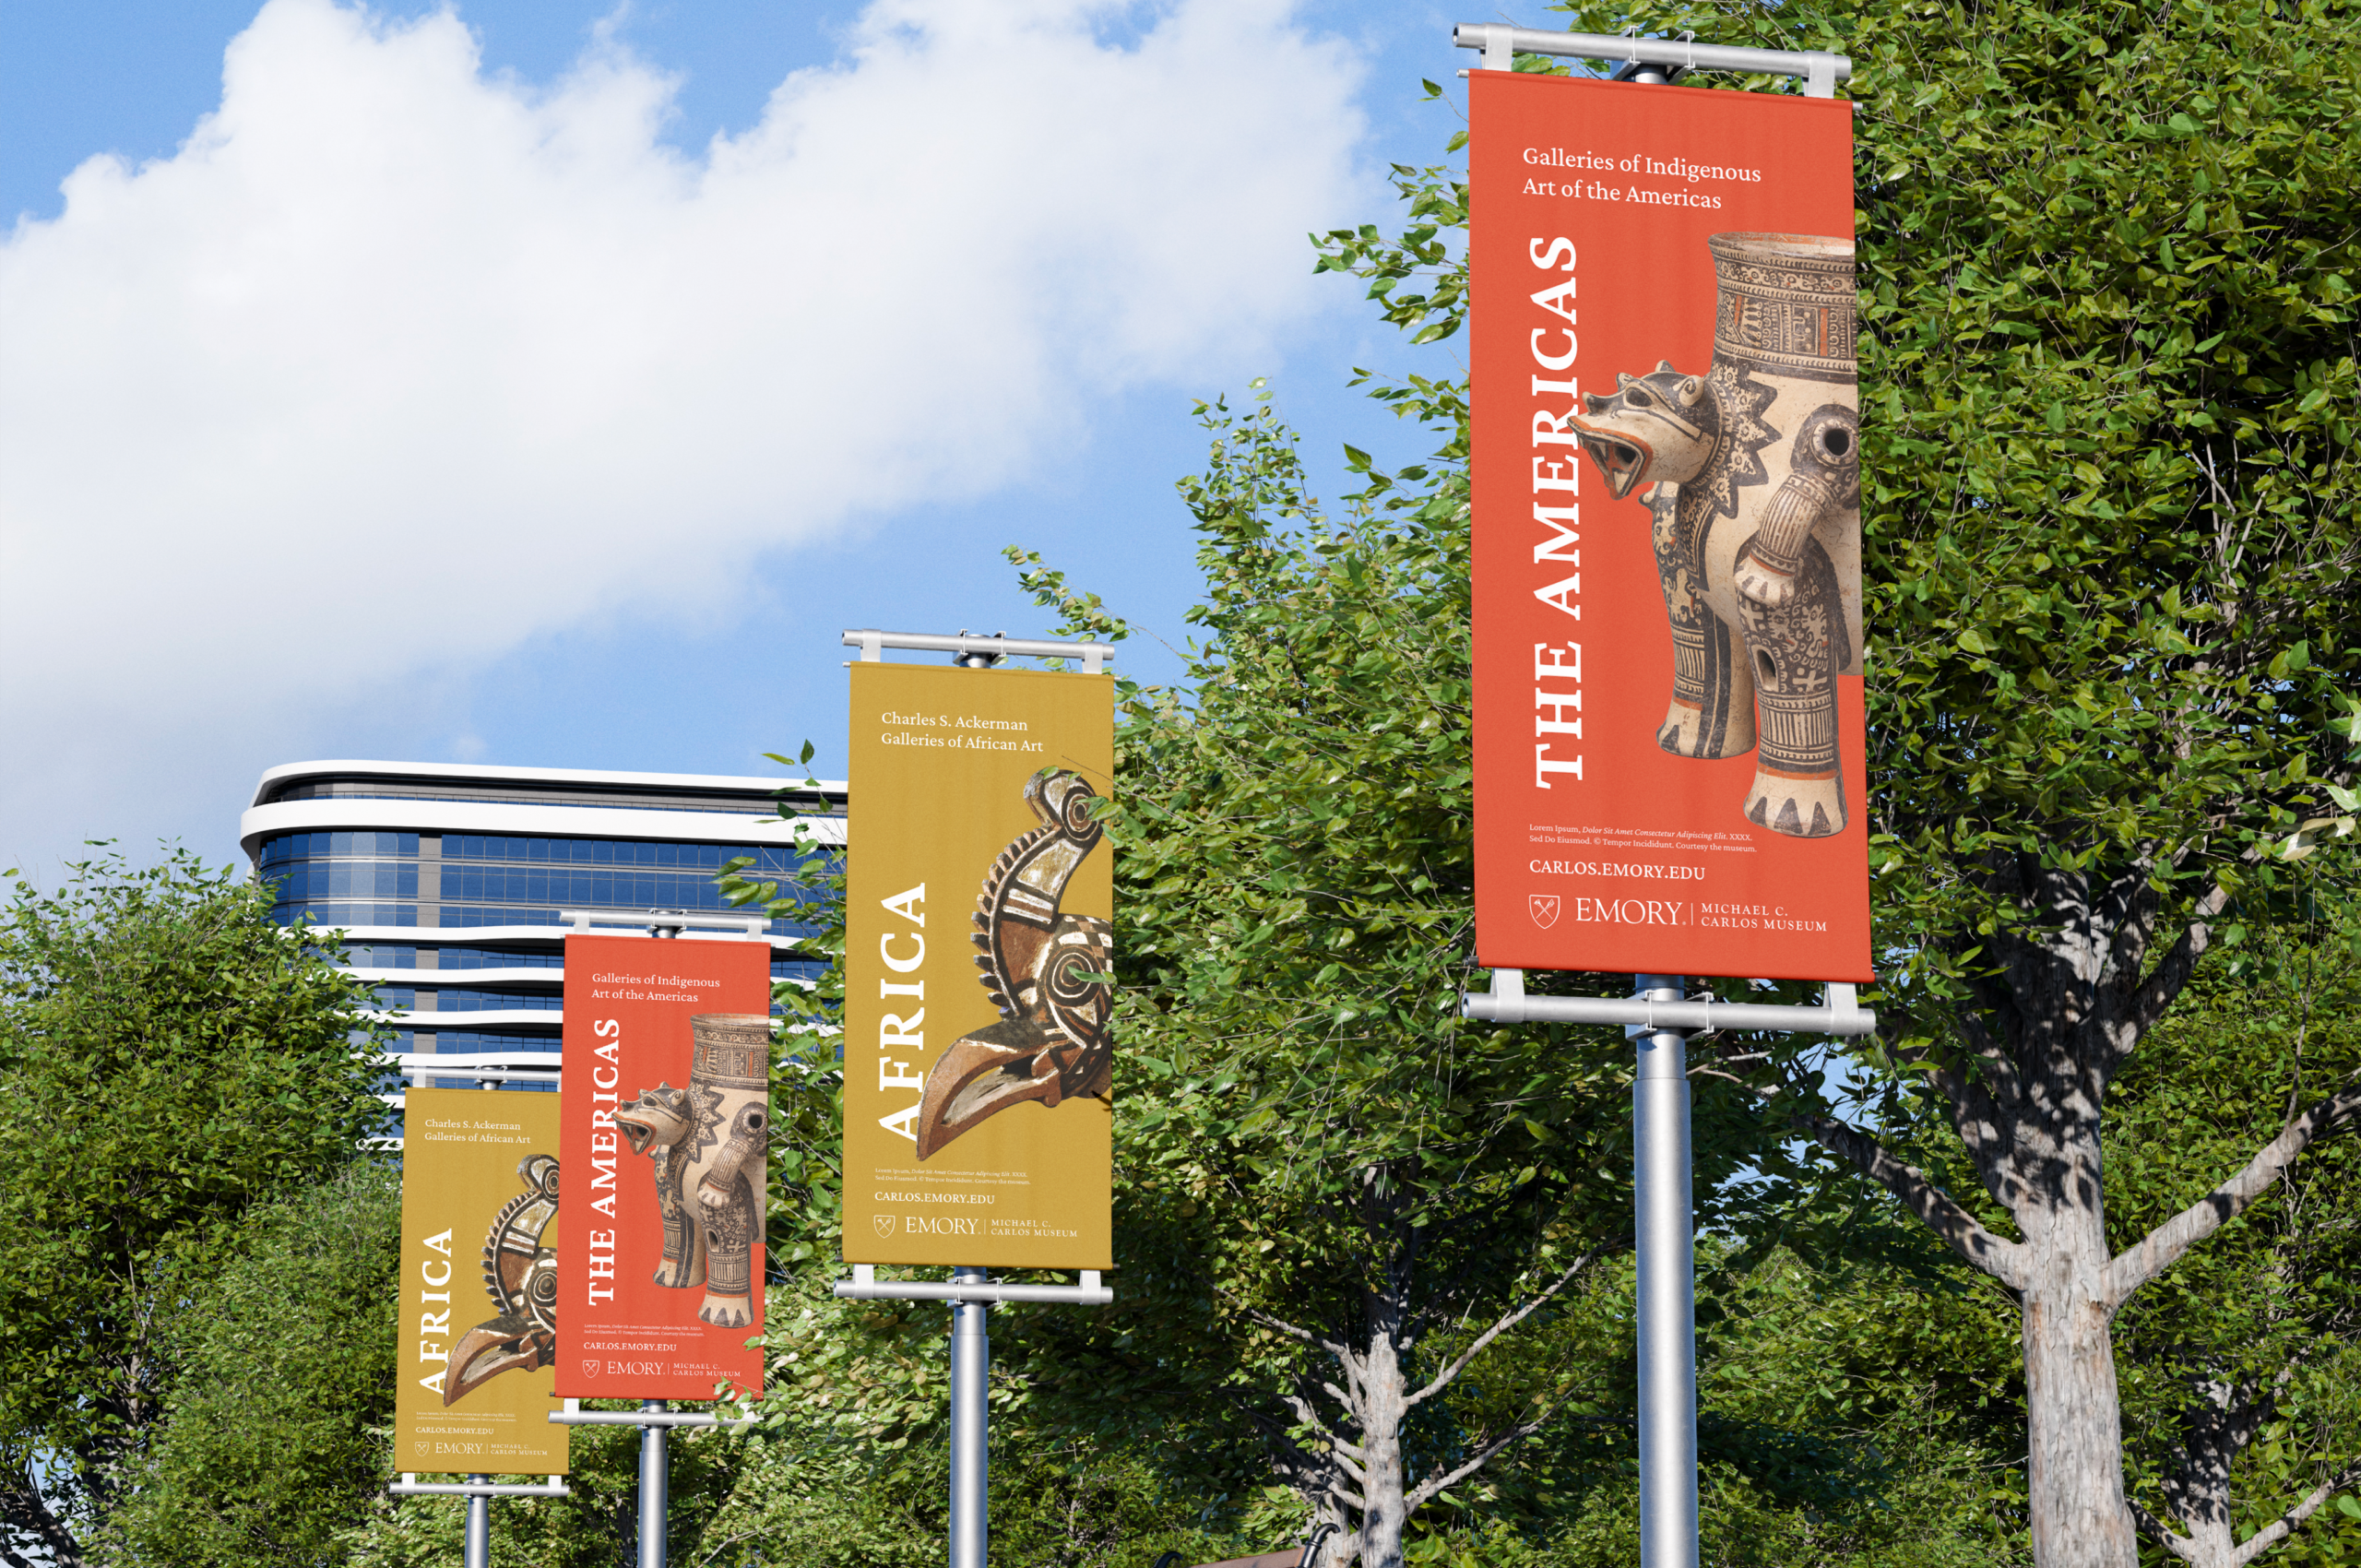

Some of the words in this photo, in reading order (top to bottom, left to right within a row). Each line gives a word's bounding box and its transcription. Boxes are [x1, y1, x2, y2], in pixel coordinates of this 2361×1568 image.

[1524, 148, 1614, 170] Galleries
[1620, 154, 1641, 172] of
[1645, 158, 1761, 183] Indigenous
[1523, 178, 1556, 196] Art
[1561, 180, 1583, 197] of
[1586, 181, 1619, 200] the
[1626, 186, 1721, 208] Americas
[1530, 237, 1580, 621] AMERICAS
[882, 711, 935, 726] Charles
[940, 716, 951, 727] S.
[955, 716, 1027, 731] Ackerman
[1535, 641, 1583, 789] THE
[882, 732, 943, 746] Galleries
[948, 735, 963, 747] of
[966, 736, 1017, 750] African
[1021, 741, 1043, 752] Art
[1555, 826, 1581, 834] Ipsum,
[1676, 831, 1712, 840] Adipiscing
[1602, 838, 1631, 848] Tempor
[1676, 842, 1708, 851] Courtesy
[1530, 860, 1705, 880] CARLOS.EMORY.EDU
[1702, 903, 1769, 918] MICHAEL
[1775, 907, 1787, 916] C.
[1702, 917, 1757, 928] CARLOS
[1764, 920, 1826, 931] MUSEUM
[592, 973, 641, 983] Galleries
[644, 975, 656, 984] of
[658, 976, 719, 989] Indigenous
[591, 990, 609, 998] Art
[612, 989, 624, 999] of
[626, 990, 644, 1000] the
[647, 992, 698, 1002] Americas
[878, 883, 925, 1142] AFRICA
[425, 1119, 460, 1128] Charles
[473, 1121, 520, 1130] Ackerman
[590, 1019, 619, 1218] AMERICAS
[425, 1132, 466, 1141] Galleries
[480, 1134, 514, 1143] African
[875, 1192, 994, 1204] CARLOS.EMORY.EDU
[588, 1229, 614, 1306] THE
[419, 1229, 453, 1395] AFRICA
[584, 1342, 676, 1351] CARLOS.EMORY.EDU
